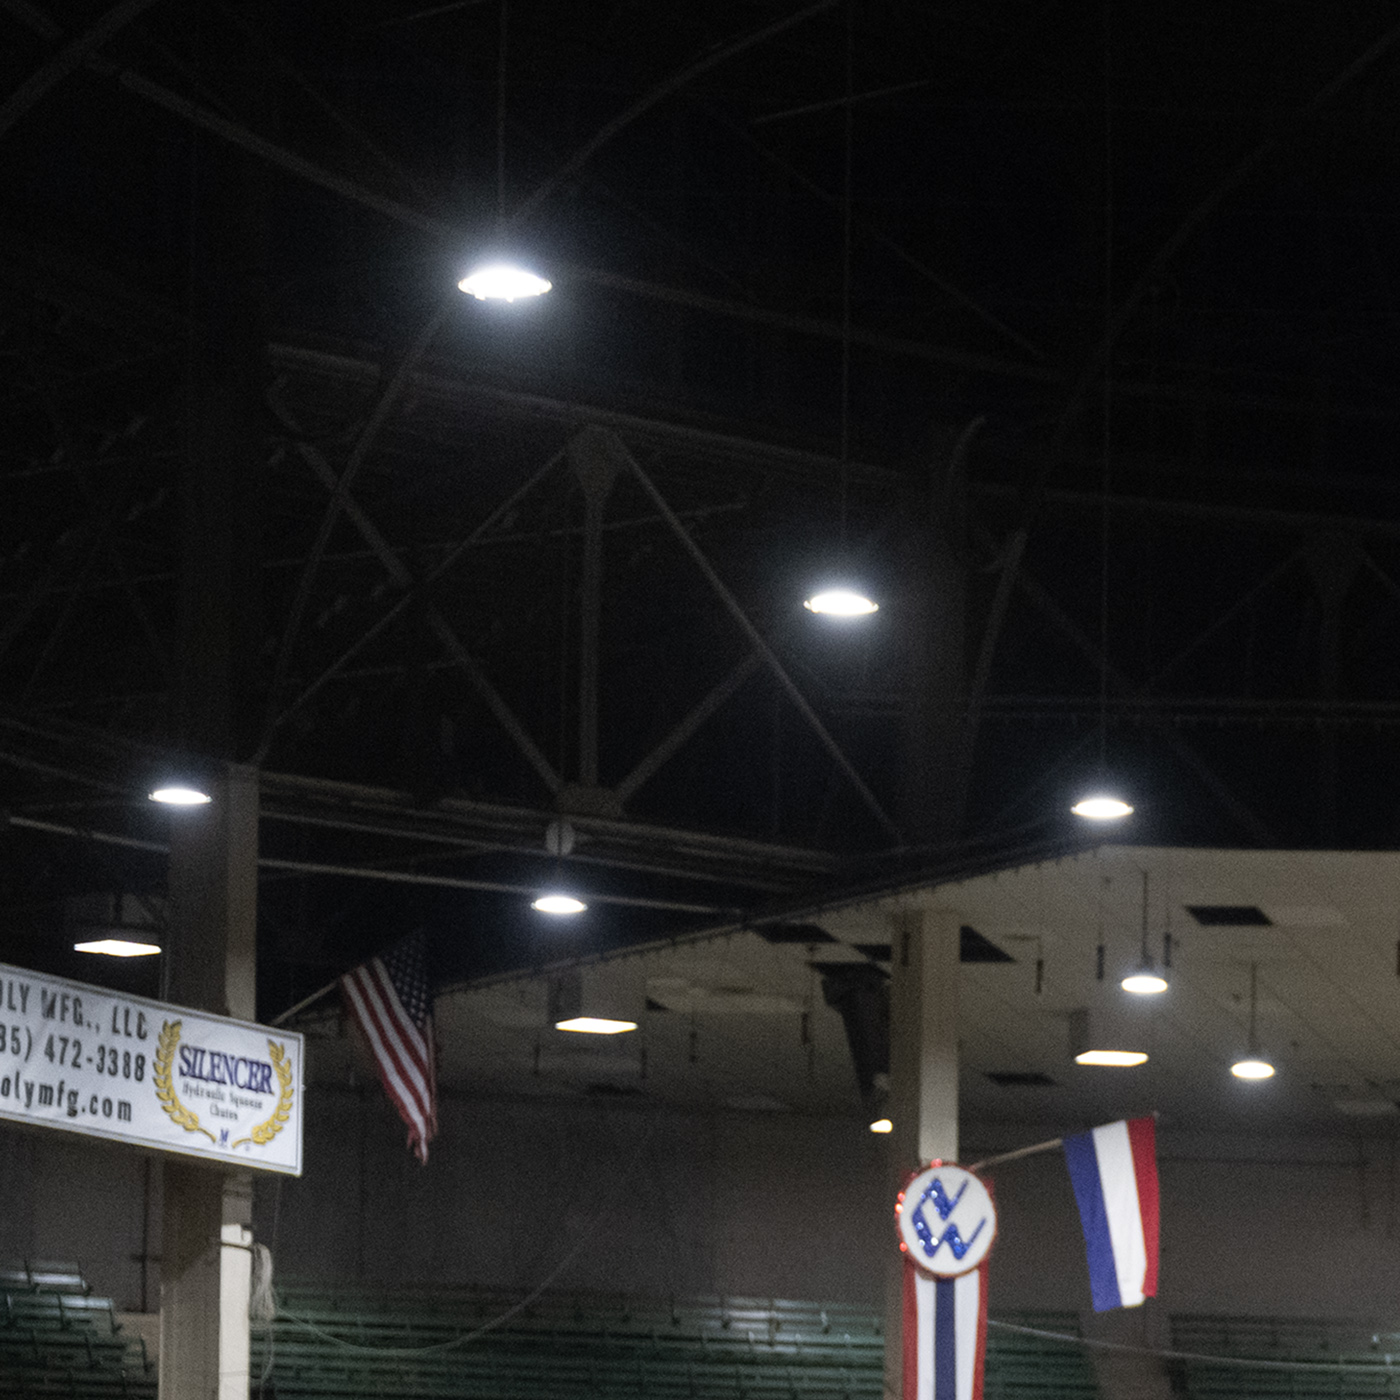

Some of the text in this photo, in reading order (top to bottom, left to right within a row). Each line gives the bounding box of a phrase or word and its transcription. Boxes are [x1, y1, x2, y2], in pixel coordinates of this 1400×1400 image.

[111, 1005, 148, 1041] LLC
[44, 1033, 146, 1083] 472-3388
[178, 1044, 275, 1095] SILENCER
